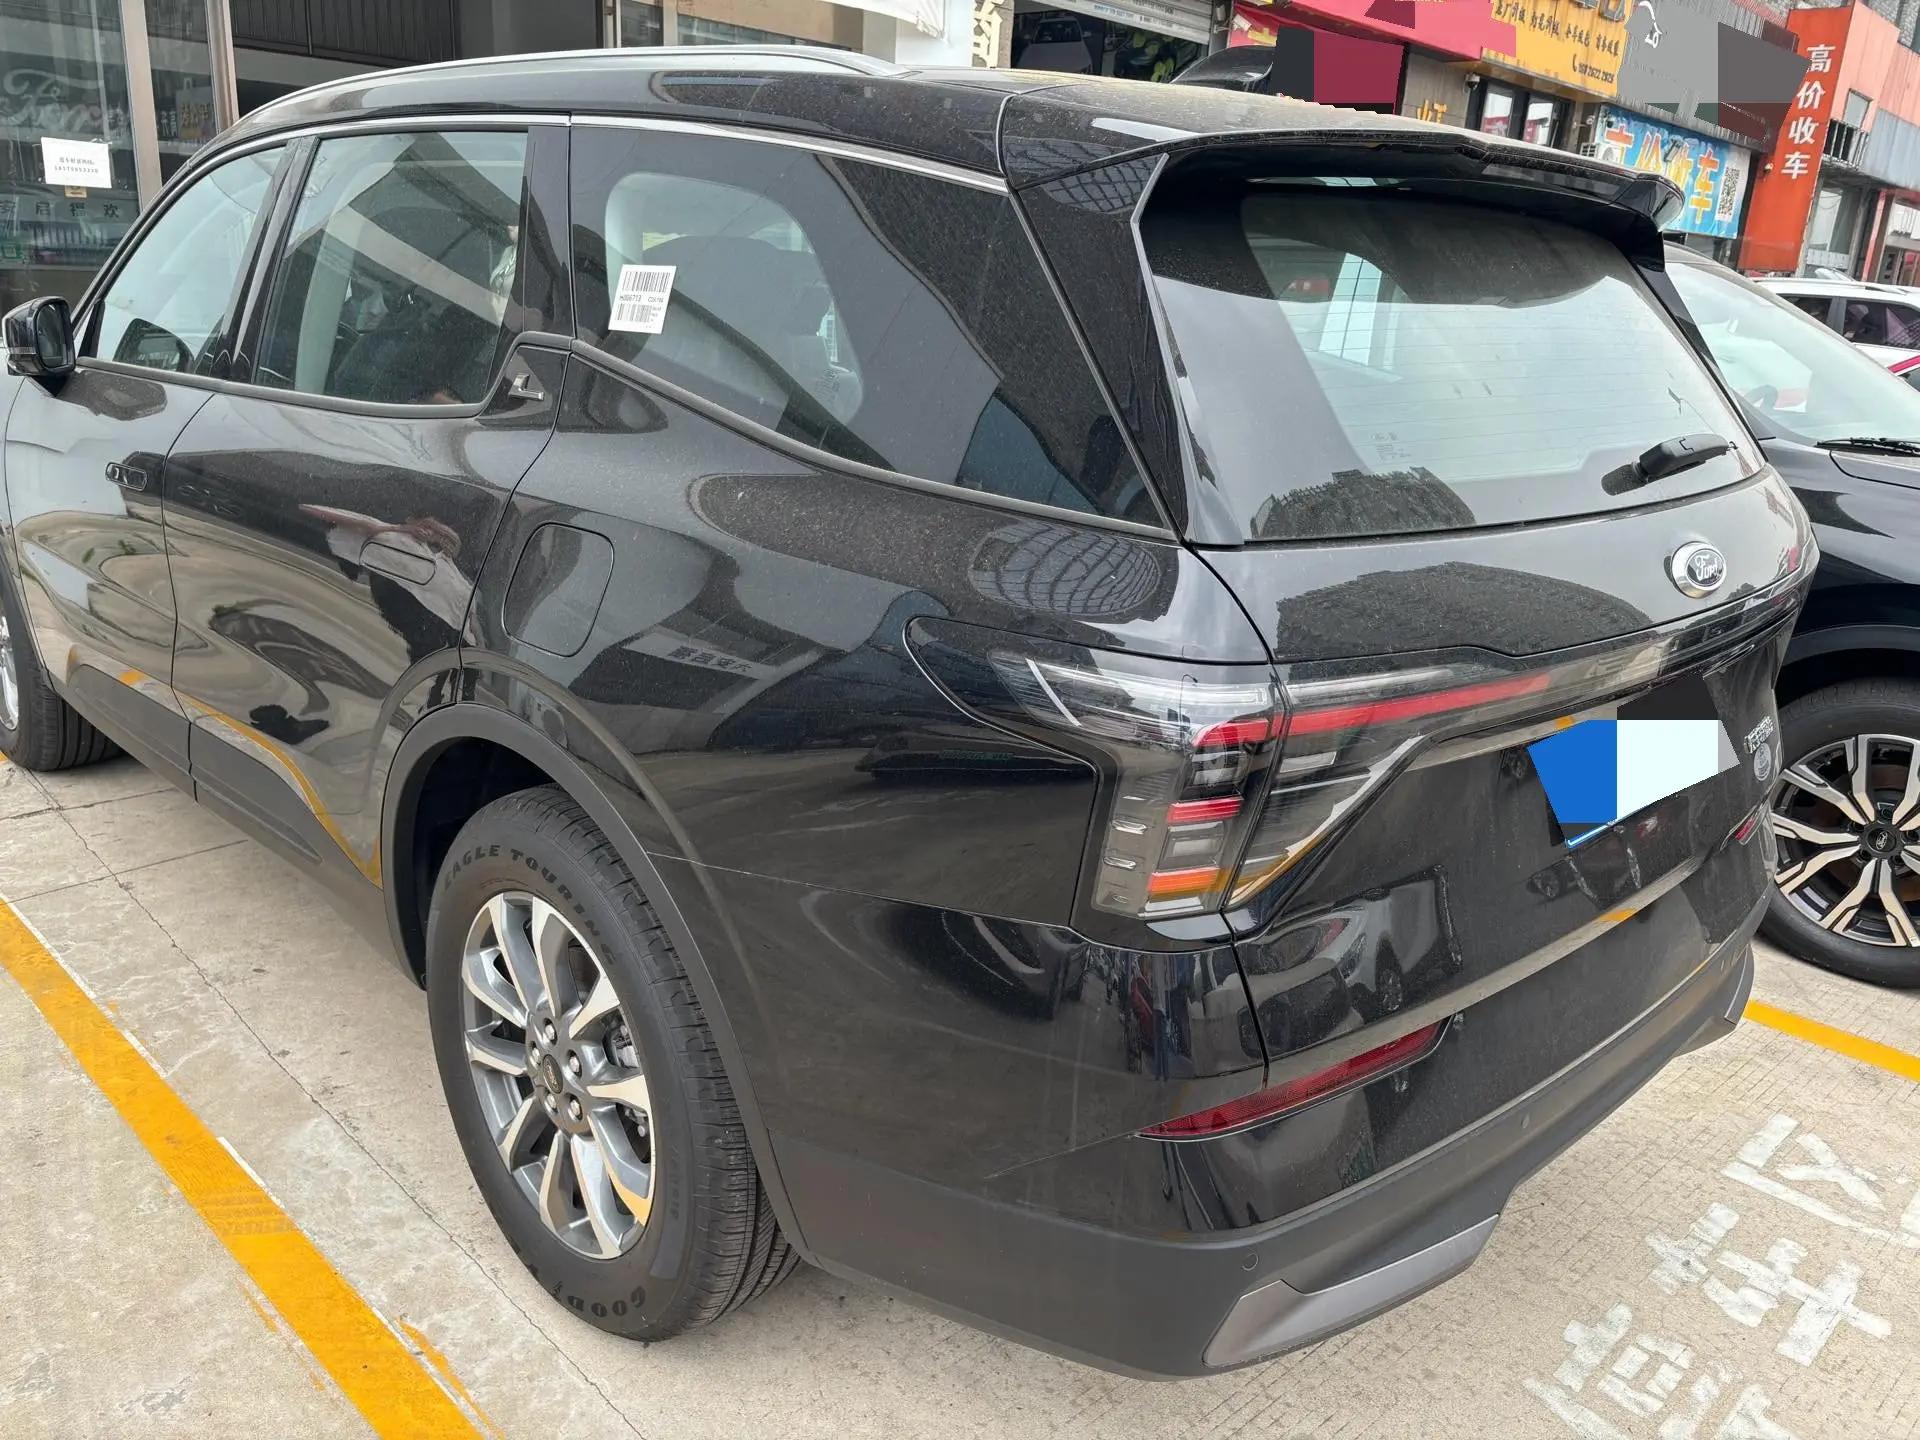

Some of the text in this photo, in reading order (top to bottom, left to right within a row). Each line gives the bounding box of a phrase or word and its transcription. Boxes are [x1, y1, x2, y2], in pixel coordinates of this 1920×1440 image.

[1781, 44, 1836, 179] 高价收车
[444, 844, 501, 890] EAGLE
